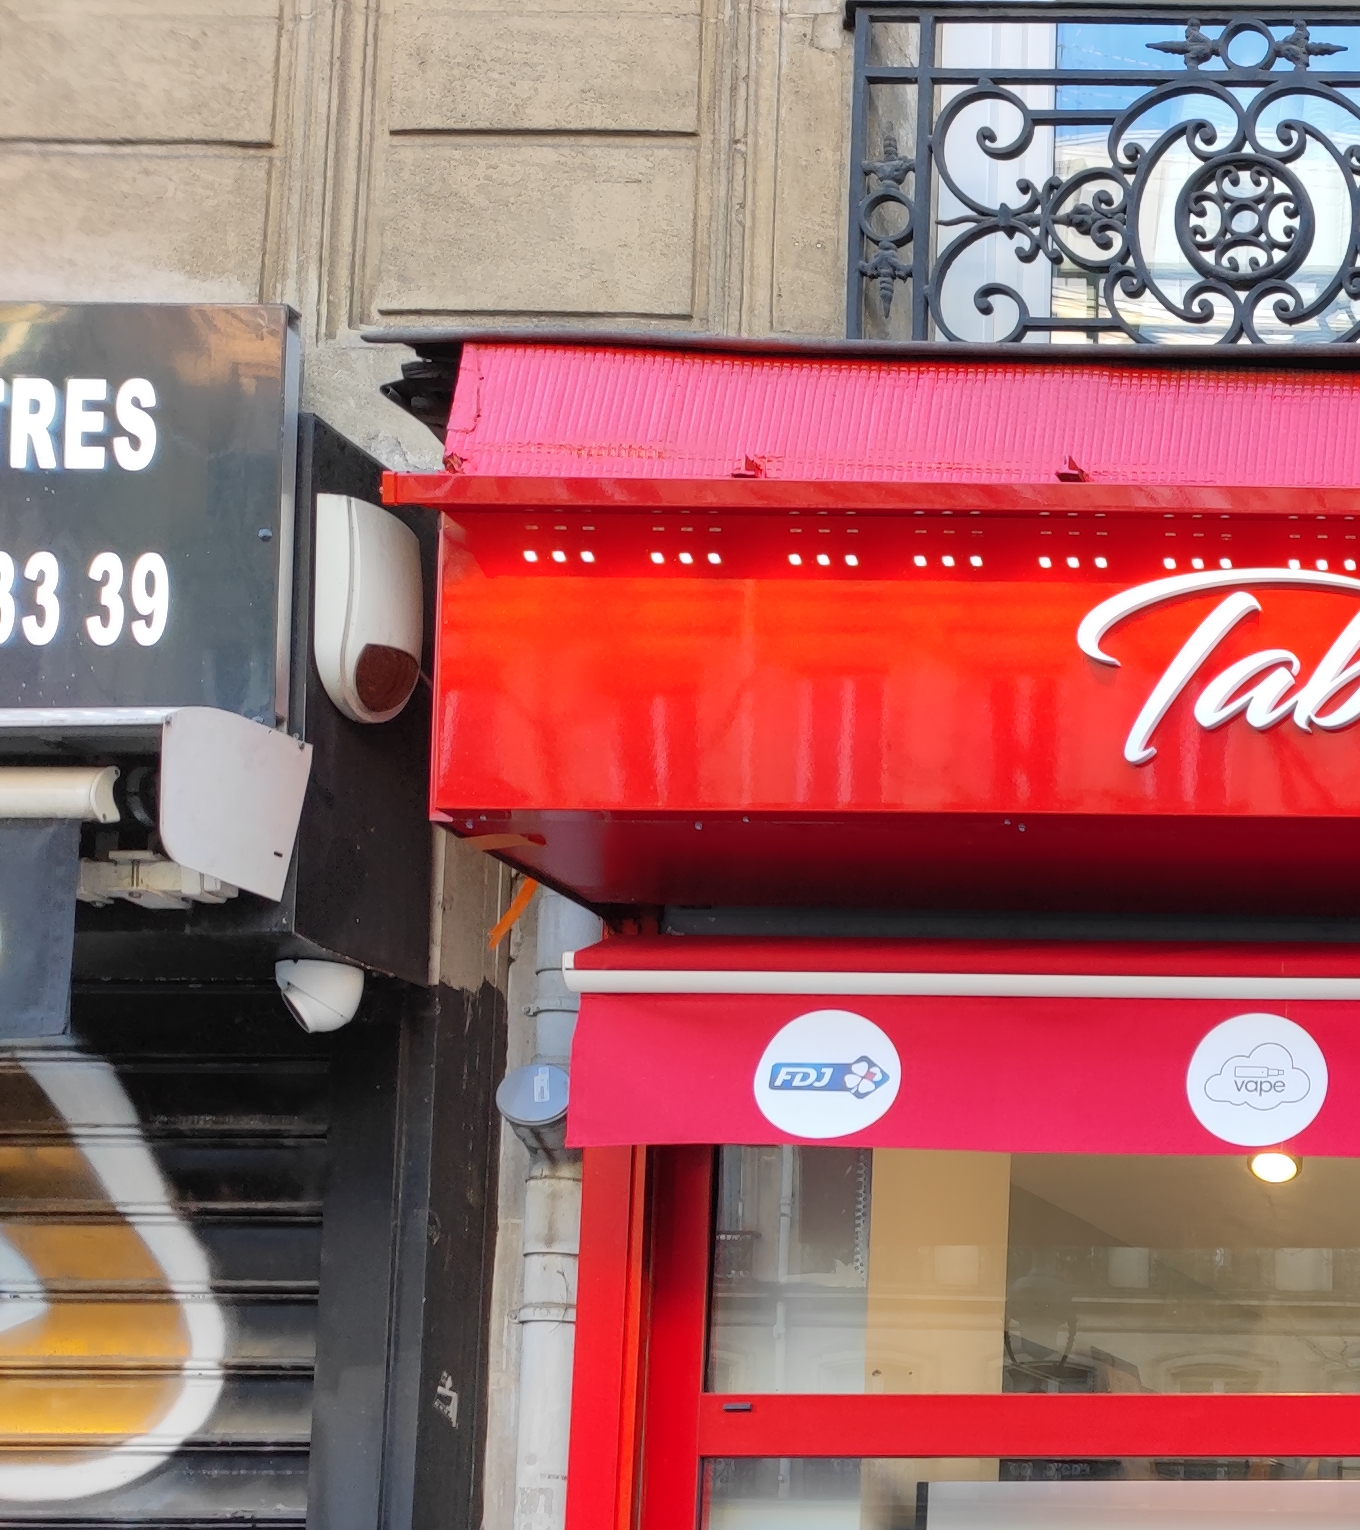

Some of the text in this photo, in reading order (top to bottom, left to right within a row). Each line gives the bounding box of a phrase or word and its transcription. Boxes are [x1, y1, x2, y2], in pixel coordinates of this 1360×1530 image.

[0, 377, 158, 472] RES
[85, 551, 170, 647] 39
[773, 1067, 834, 1087] FDJ
[1233, 1079, 1287, 1098] vape
